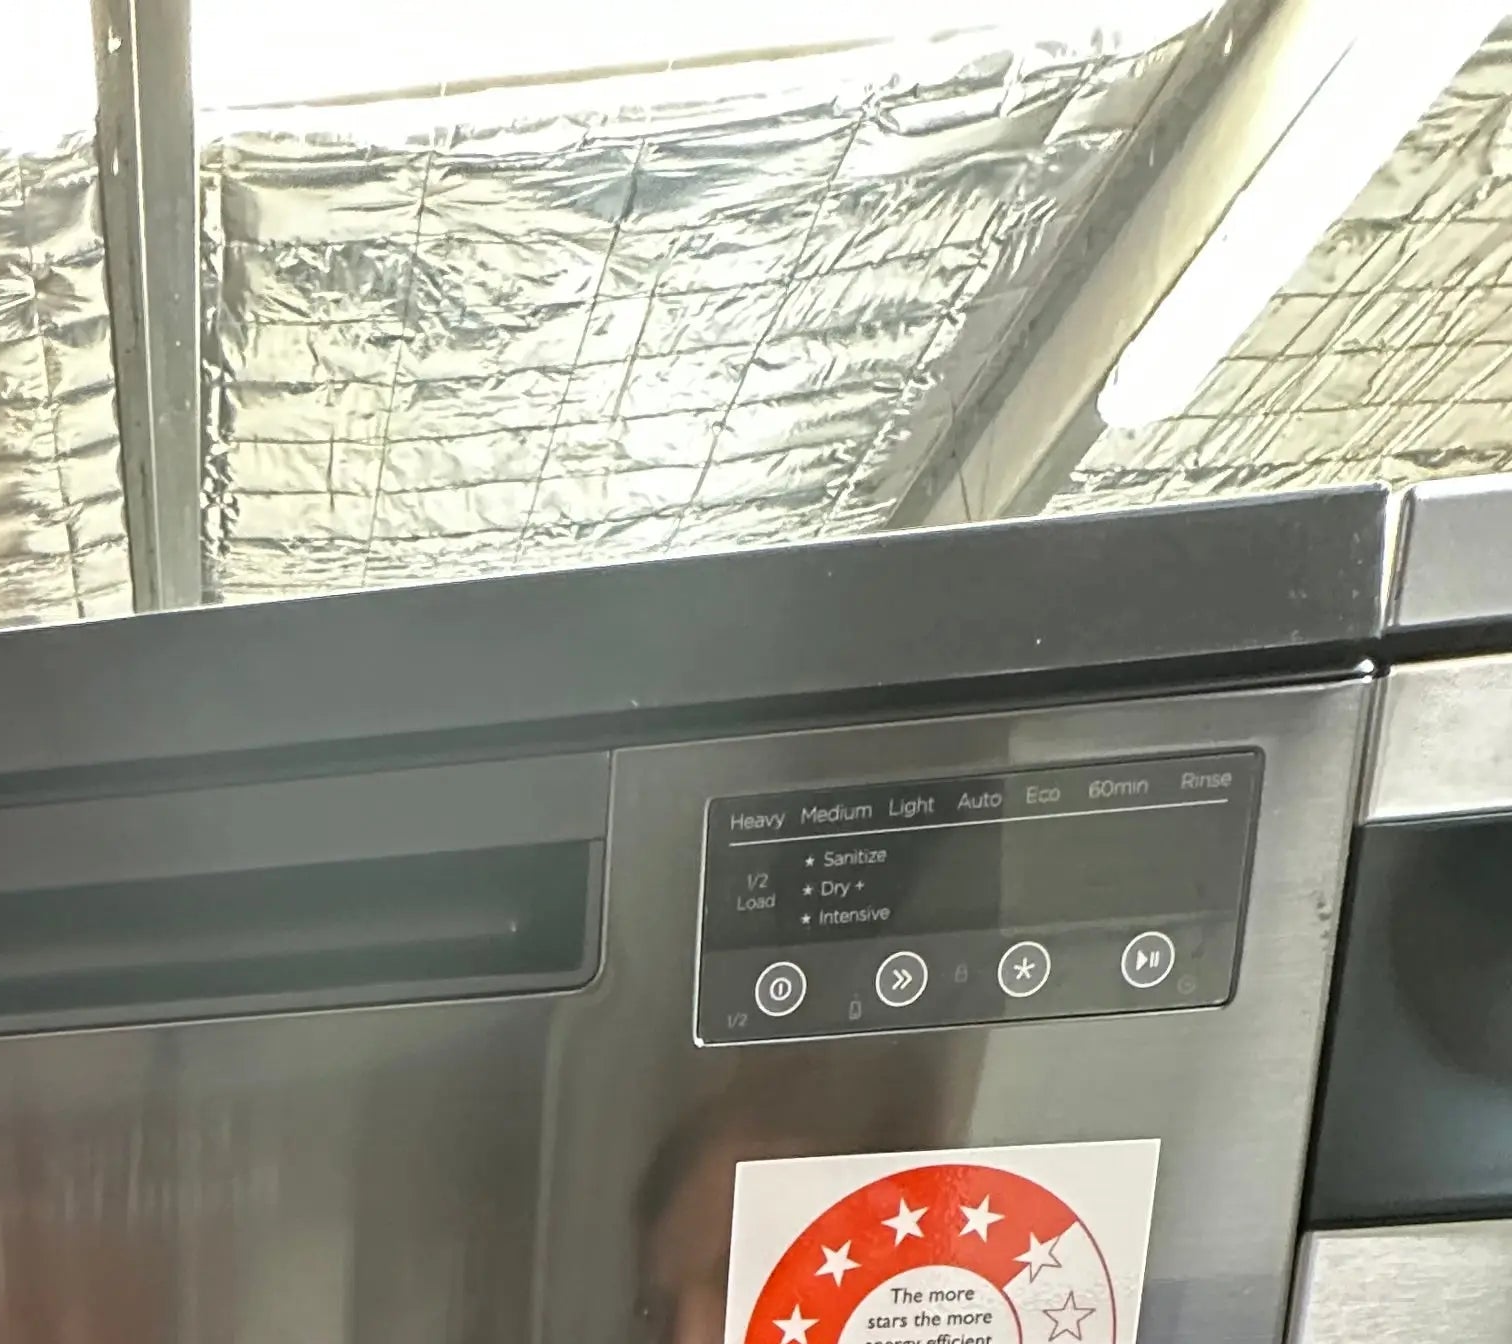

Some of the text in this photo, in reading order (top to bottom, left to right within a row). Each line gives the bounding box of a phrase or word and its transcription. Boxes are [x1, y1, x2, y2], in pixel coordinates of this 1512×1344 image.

[1088, 779, 1149, 799] 60min
[1180, 771, 1233, 790] Rinse
[957, 791, 1003, 811] Auto
[1025, 786, 1061, 804] Eco
[800, 804, 873, 824] Medium
[888, 796, 935, 818] Light
[730, 811, 786, 831] Heavy
[823, 849, 887, 867] Sanitize
[820, 880, 851, 898] Dry
[736, 894, 776, 911] Load
[818, 905, 891, 925] Intensive
[890, 1287, 975, 1305] The more
[867, 1310, 993, 1330] stars the more
